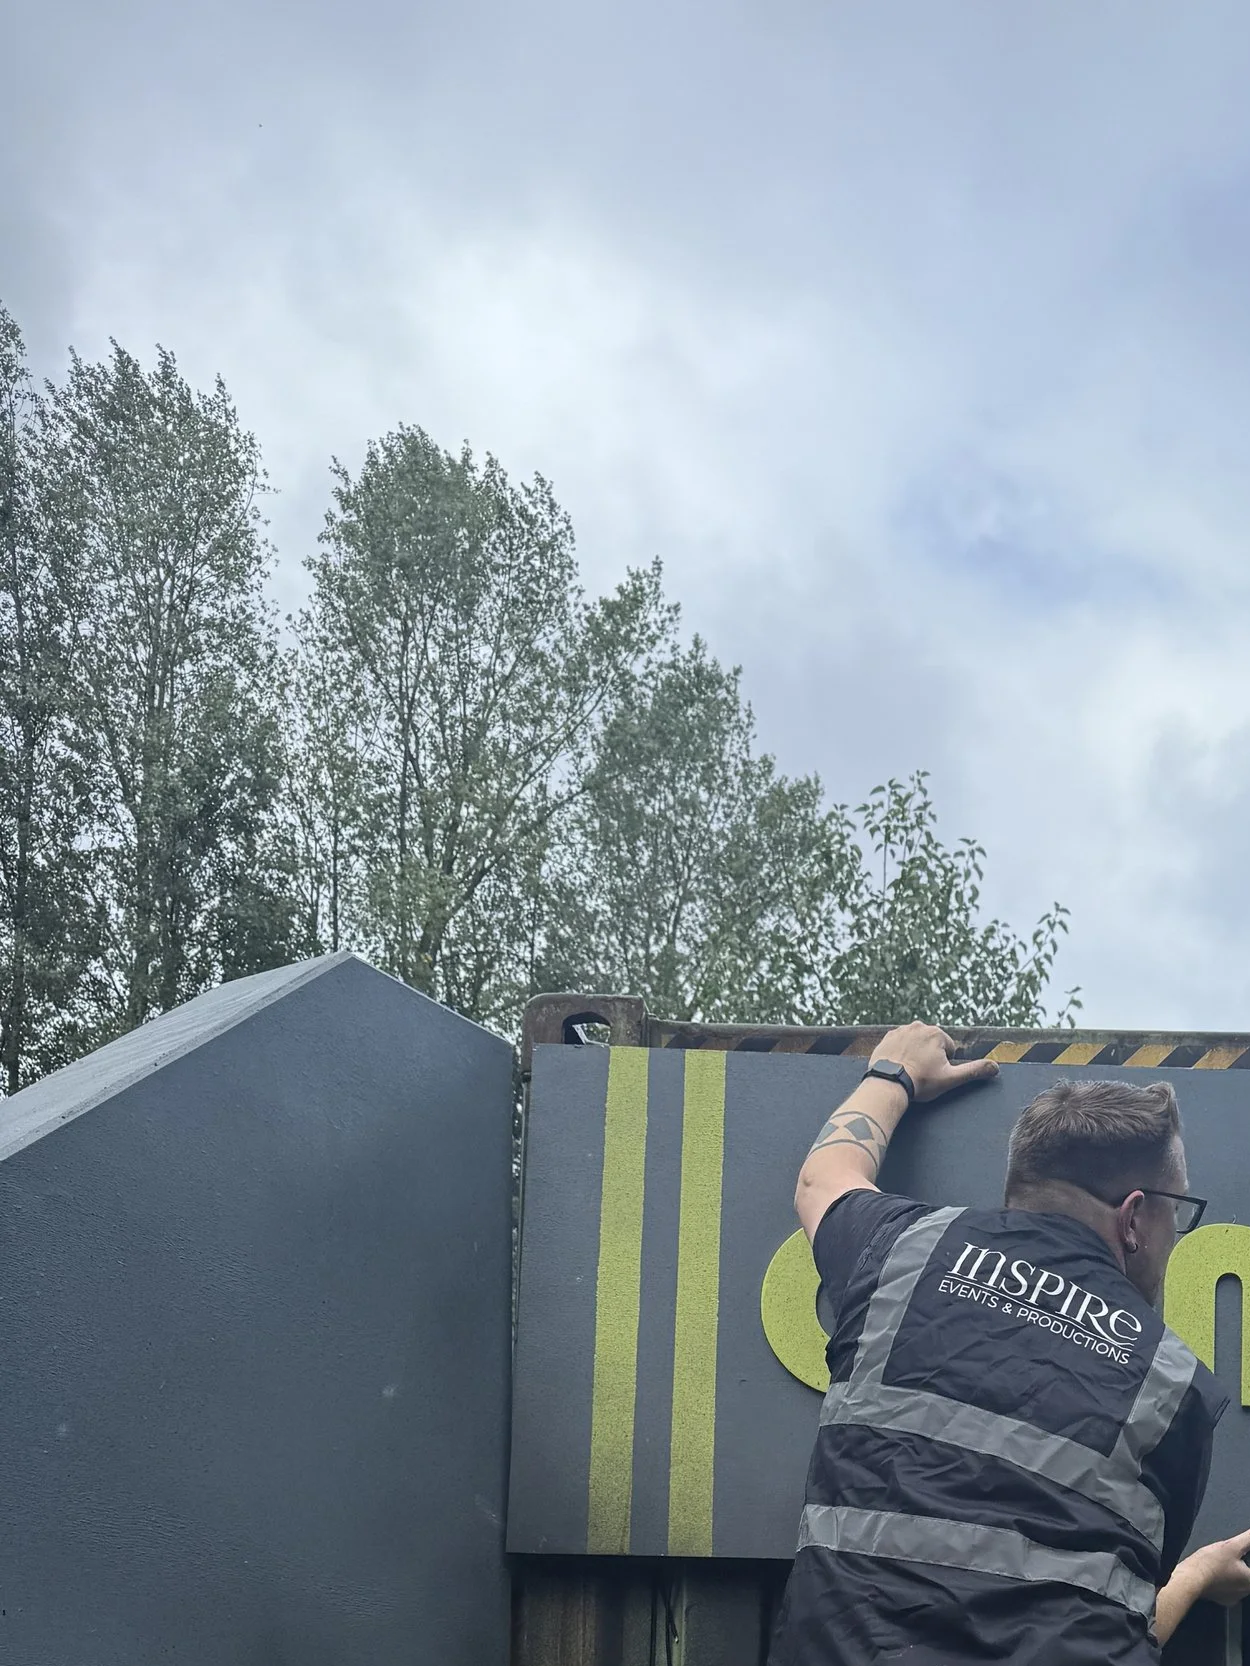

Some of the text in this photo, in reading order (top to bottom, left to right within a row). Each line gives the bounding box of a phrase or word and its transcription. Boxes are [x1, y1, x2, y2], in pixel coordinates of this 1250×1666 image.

[938, 1280, 1130, 1365] EVENTS & PRODUCTIONS
[947, 1242, 1142, 1346] INSPIRE
